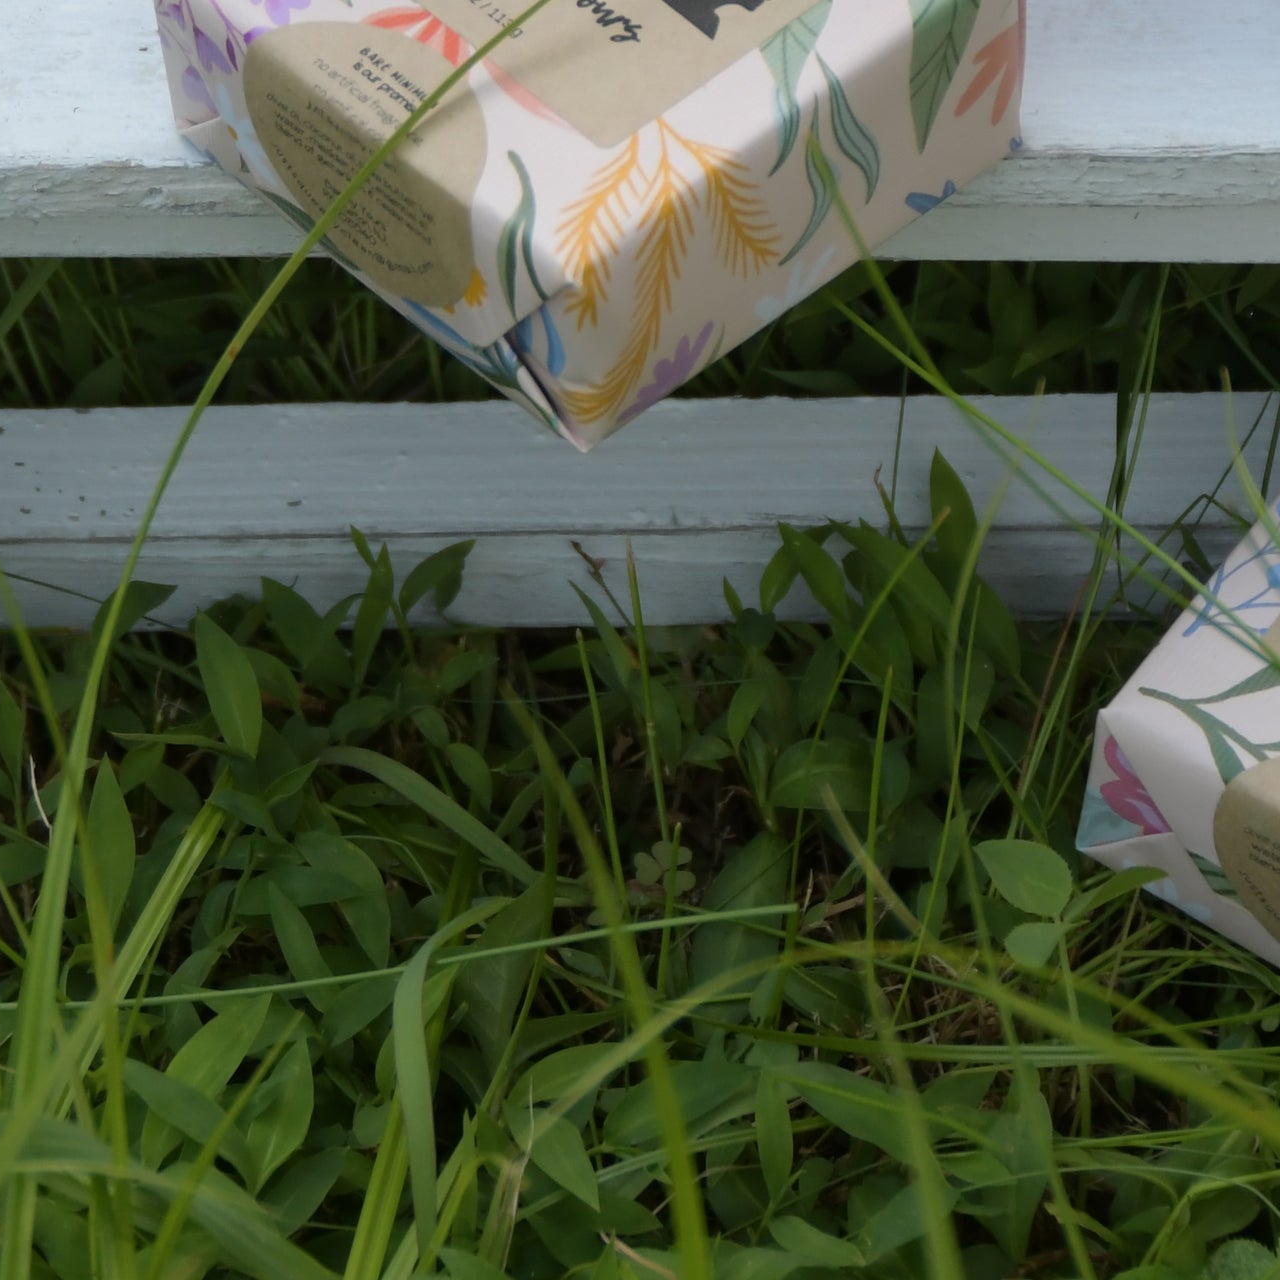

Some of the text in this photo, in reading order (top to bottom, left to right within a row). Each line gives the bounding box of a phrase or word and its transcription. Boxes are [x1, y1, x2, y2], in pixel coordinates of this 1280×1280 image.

[478, 1, 493, 10] /
[359, 47, 391, 72] BARE
[359, 65, 382, 90] our
